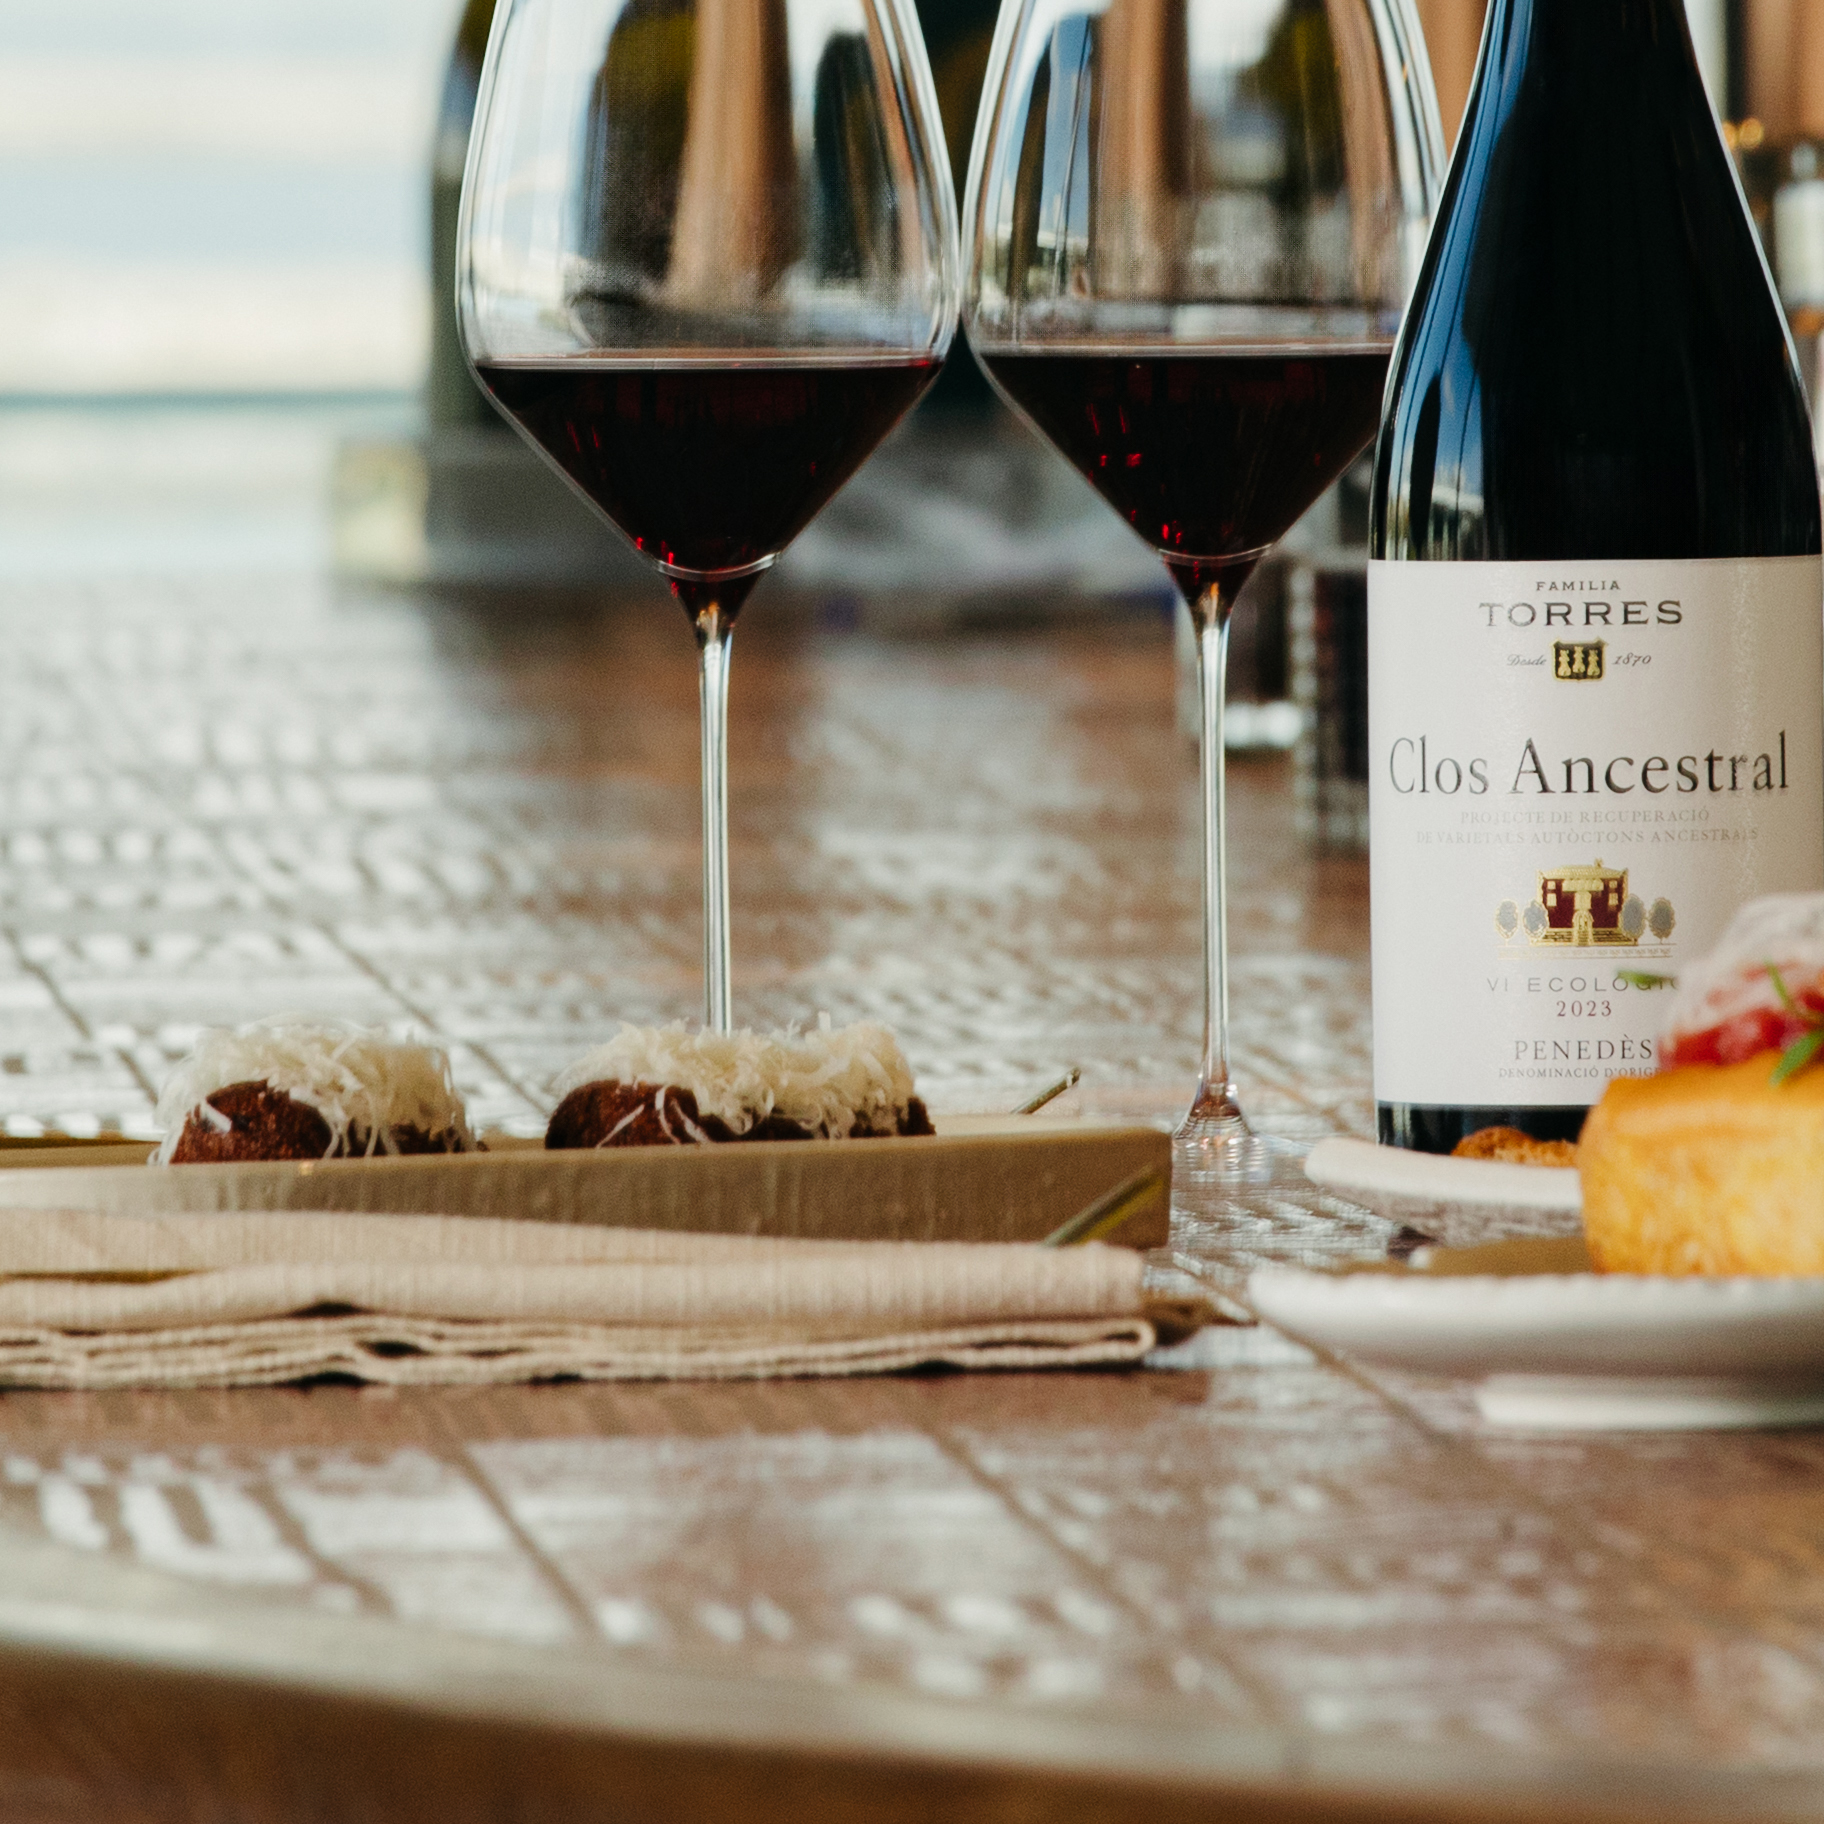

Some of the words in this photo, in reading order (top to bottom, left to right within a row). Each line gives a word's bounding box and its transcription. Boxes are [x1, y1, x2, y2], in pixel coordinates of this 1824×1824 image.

[1535, 580, 1621, 591] FAMILIA
[1479, 599, 1683, 627] TORRES
[1506, 653, 1547, 666] Desde
[1611, 652, 1652, 667] 1870
[1389, 734, 1490, 795] Clos
[1506, 729, 1790, 795] Ancestral
[1460, 811, 1545, 825] PROJECTE
[1550, 810, 1573, 824] DE
[1579, 805, 1710, 824] RECUPERACIÓ
[1416, 831, 1433, 844] DE
[1436, 831, 1525, 845] VARIETALS
[1530, 827, 1644, 845] AUTÒCTONS
[1486, 977, 1509, 993] VI
[1556, 999, 1613, 1018] 2023
[1514, 1033, 1653, 1061] PENEDÈS
[1498, 1065, 1599, 1079] DENOMINACIÓ
